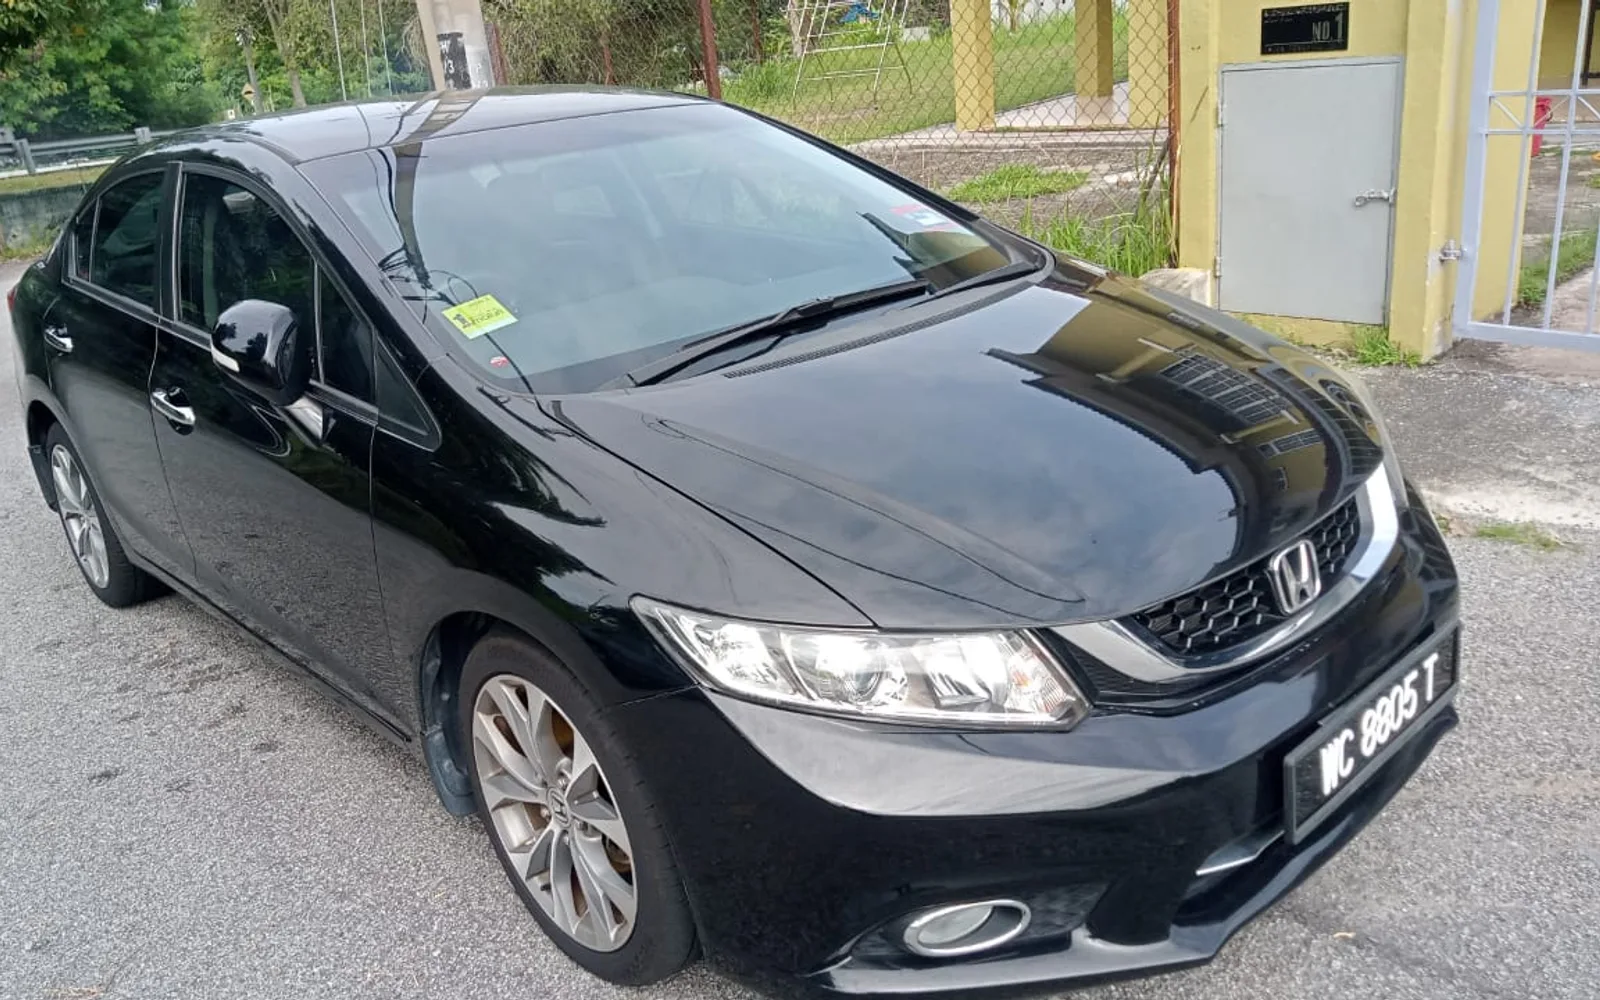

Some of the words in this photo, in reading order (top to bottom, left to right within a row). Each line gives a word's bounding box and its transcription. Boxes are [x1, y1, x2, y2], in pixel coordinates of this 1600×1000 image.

[1319, 728, 1355, 796] WC
[1360, 670, 1419, 757] 8805
[1422, 652, 1439, 702] T
